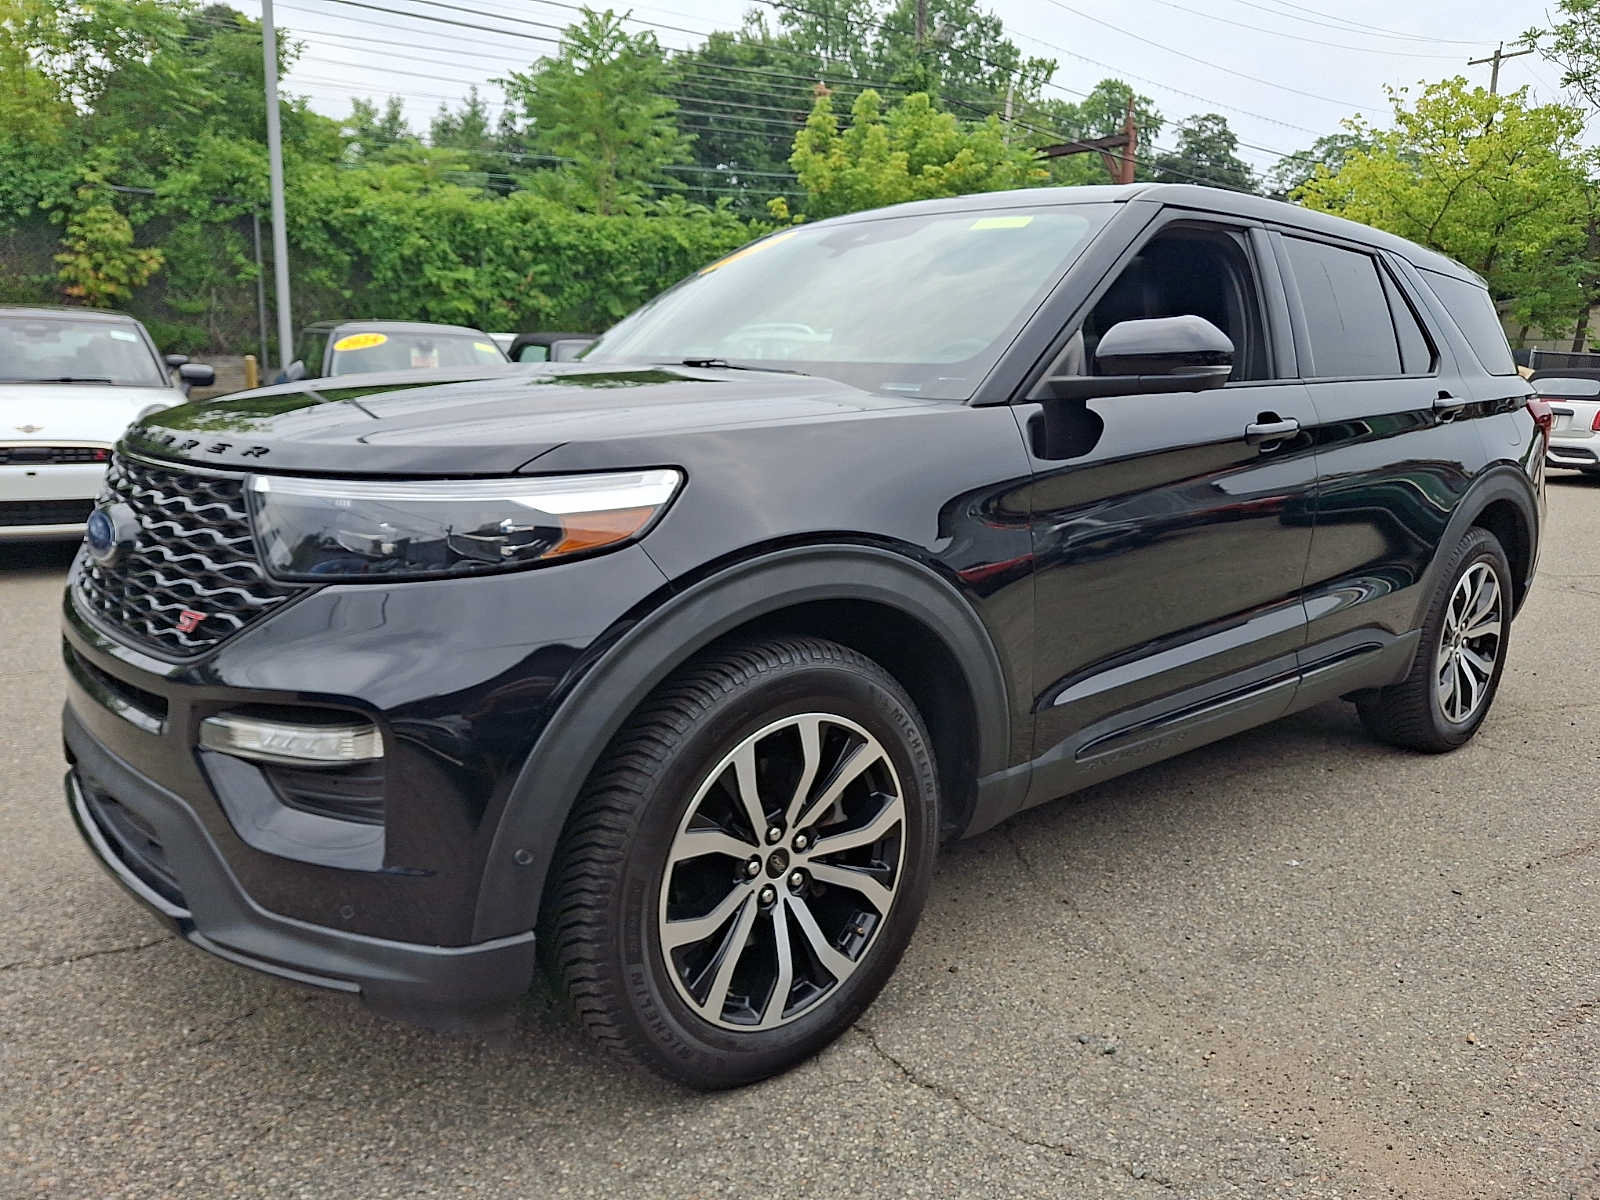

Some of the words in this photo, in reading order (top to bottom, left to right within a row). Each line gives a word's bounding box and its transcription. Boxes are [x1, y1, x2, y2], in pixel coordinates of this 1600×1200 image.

[176, 609, 208, 633] ST
[891, 707, 934, 793] MICHELIN
[631, 971, 691, 1059] MICHELIN
